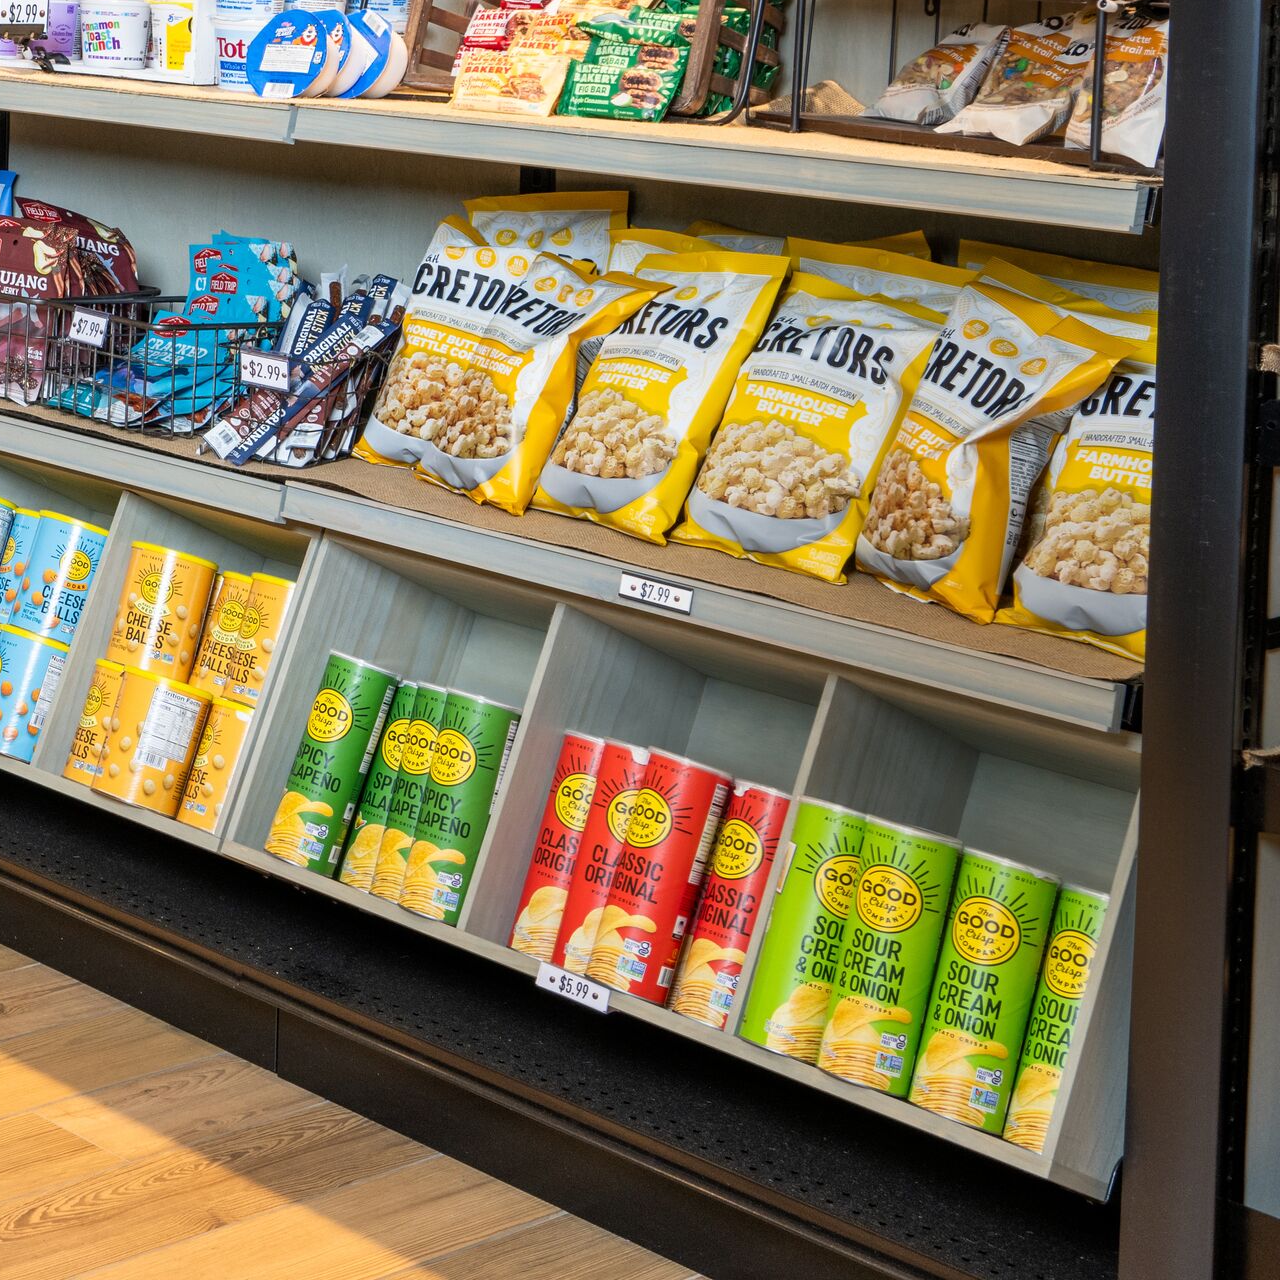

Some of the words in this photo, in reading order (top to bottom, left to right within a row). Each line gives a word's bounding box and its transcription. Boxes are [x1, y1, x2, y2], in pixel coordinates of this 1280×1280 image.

[9, 3, 38, 24] $2.99
[87, 30, 111, 41] Toast
[596, 45, 635, 57] BAKERY
[1120, 45, 1142, 54] trail
[465, 65, 510, 74] BAKERY
[574, 73, 616, 84] BAKERY
[578, 86, 591, 94] FIG
[1, 286, 19, 296] JERKY
[211, 279, 224, 290] FIELD
[225, 281, 238, 292] TRIP
[76, 322, 99, 338] $7.99
[294, 308, 317, 355] ORIGINAL
[406, 324, 444, 344] HONEY
[144, 337, 208, 360] CRACKED
[304, 322, 352, 364] ORIGINAL
[753, 324, 894, 385] CRETORS
[249, 361, 281, 381] $2.99
[595, 362, 671, 384] FARMHOUSE
[598, 373, 648, 391] BUTTER
[752, 367, 789, 381] HANDCRAFTED
[789, 375, 828, 392] SMALL-BATCH
[829, 386, 858, 400] POPCORN
[745, 384, 849, 419] FARMHOUSE
[756, 398, 824, 428] BUTTER
[238, 408, 286, 452] ORIGINAL
[640, 582, 670, 603] $7.99
[126, 612, 173, 636] CHEESE
[313, 701, 348, 722] GOOD
[325, 697, 335, 705] The
[314, 715, 332, 727] Crisp
[434, 742, 472, 762] GOOD
[719, 834, 758, 856] GOOD
[720, 851, 740, 861] Crisp
[880, 875, 896, 886] The
[862, 879, 918, 906] GOOD
[862, 903, 908, 926] COMPANY
[868, 895, 901, 916] Crisp
[978, 907, 994, 918] The
[958, 911, 1015, 939] GOOD
[852, 928, 902, 962] SOUR
[959, 935, 1003, 958] COMPANY
[965, 928, 997, 947] Crisp
[843, 948, 905, 985] CREAM
[558, 975, 589, 1000] $5.99
[839, 971, 848, 987] &
[849, 974, 901, 1005] ONION
[947, 961, 999, 994] SOUR
[938, 982, 1002, 1020] CREAM
[933, 1005, 942, 1020] &
[944, 1008, 997, 1039] ONION
[931, 1026, 956, 1041] POTATO
[958, 1034, 988, 1050] CRISPS
[976, 1074, 987, 1082] FREE
[977, 1069, 993, 1079] GLUTEN
